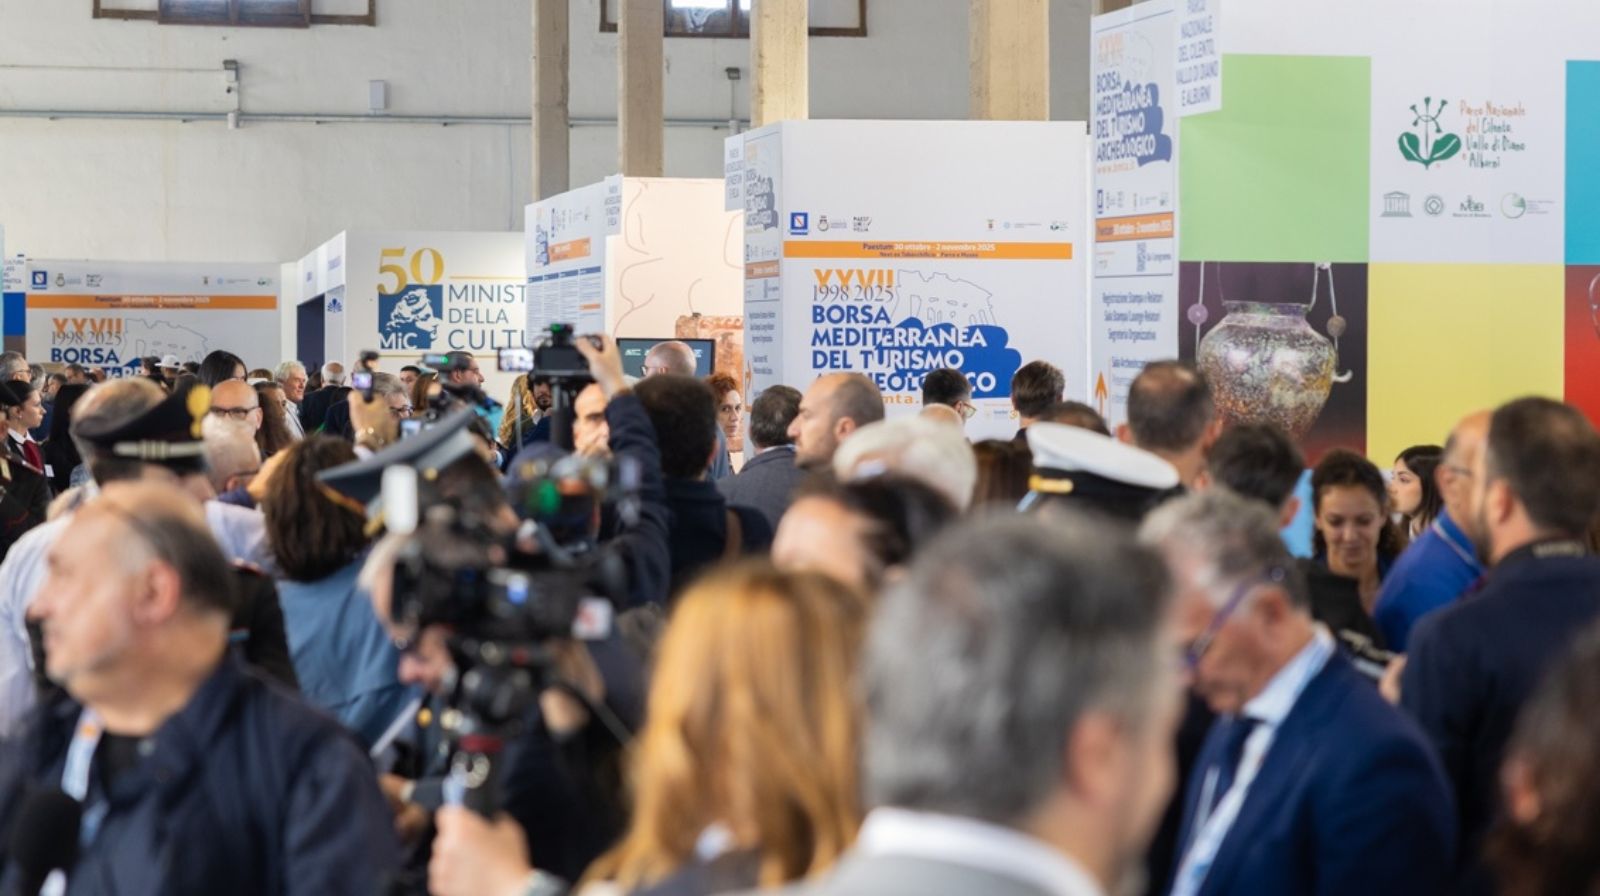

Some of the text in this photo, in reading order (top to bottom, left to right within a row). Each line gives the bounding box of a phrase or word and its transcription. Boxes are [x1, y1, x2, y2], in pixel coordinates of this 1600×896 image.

[1096, 70, 1122, 94] BORSA
[1096, 88, 1153, 116] MEDITERRANEA
[1459, 99, 1526, 118] Parco Nazionale
[1096, 133, 1157, 162] ARCHEOLOGICO
[1465, 135, 1489, 152] Vallo
[1468, 151, 1501, 169] Alburni
[863, 243, 894, 251] Paestum
[977, 243, 996, 251] 2025
[377, 247, 445, 296] 50
[812, 284, 894, 302] 1998 2025
[448, 308, 509, 325] DELLA
[811, 304, 892, 325] BORSA
[51, 330, 122, 346] 1998 2025
[378, 332, 418, 351] MiC
[810, 326, 988, 348] MEDITERRANEA
[51, 348, 119, 364] BORSA
[811, 349, 965, 371] DEL TURISMO
